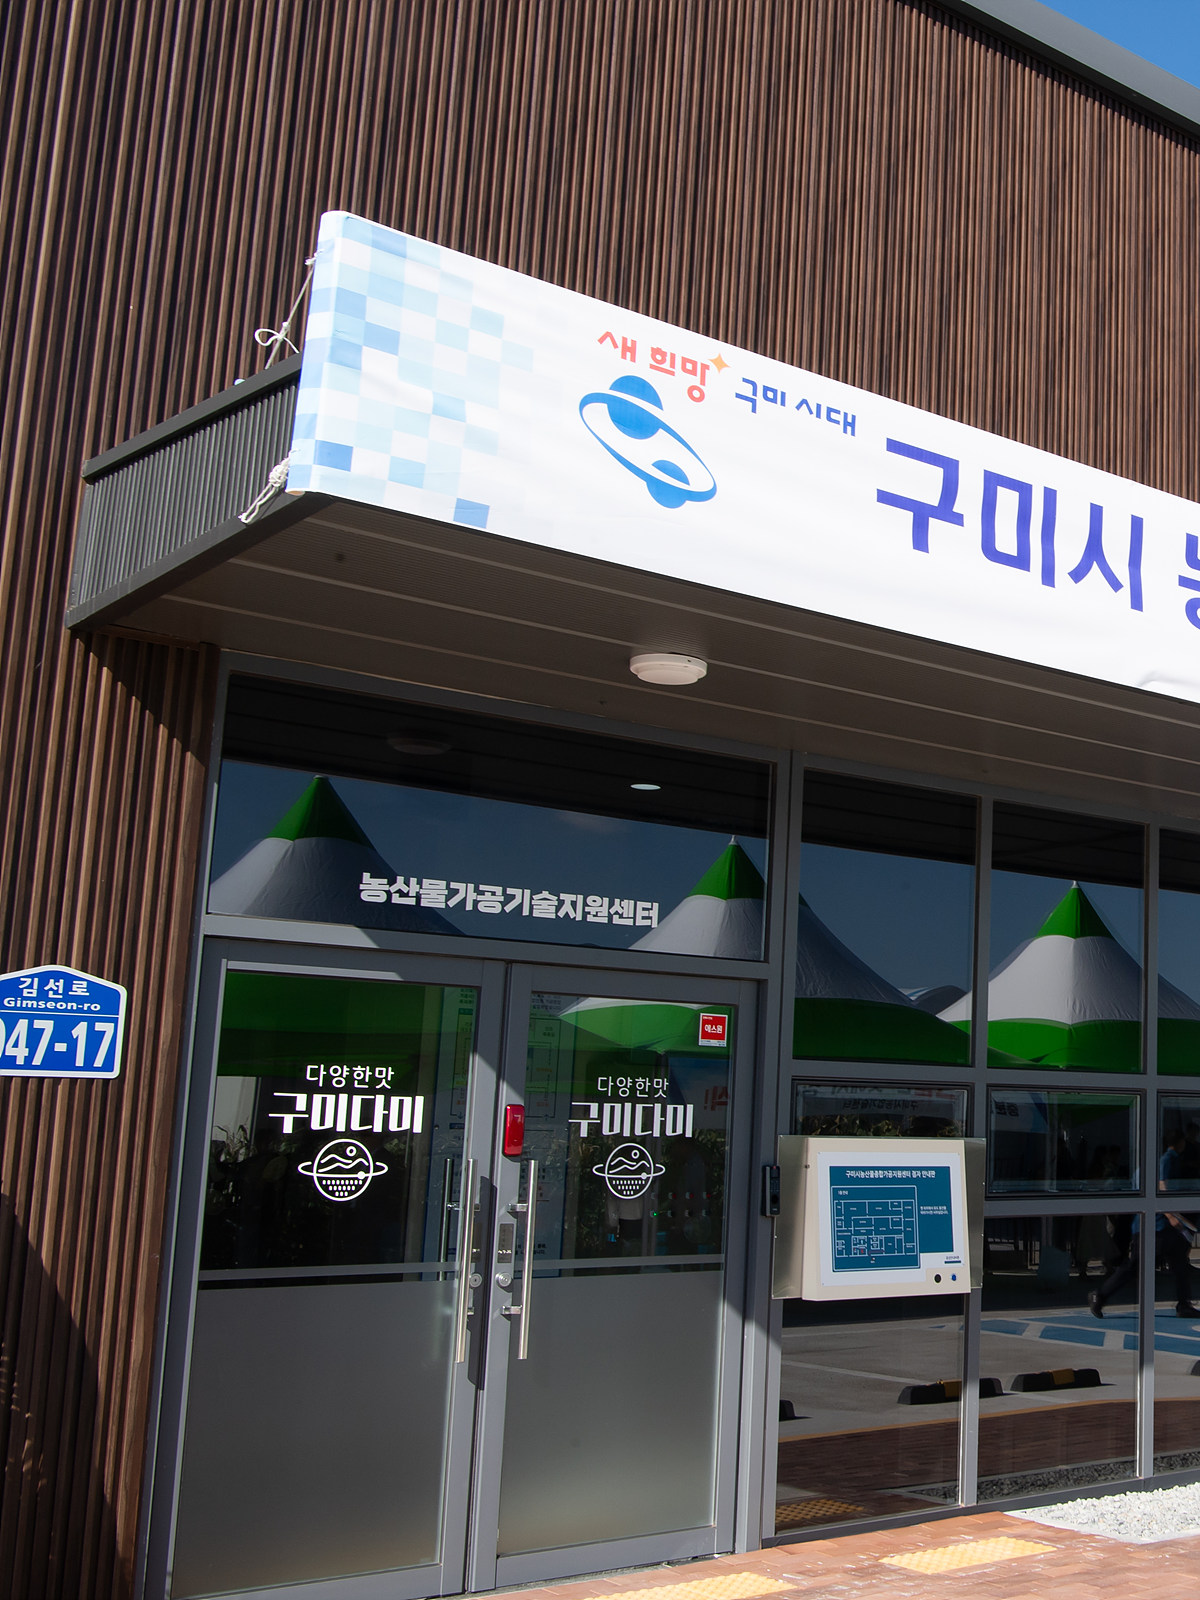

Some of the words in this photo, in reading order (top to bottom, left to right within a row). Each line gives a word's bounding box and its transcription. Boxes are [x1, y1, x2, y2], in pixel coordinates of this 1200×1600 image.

[876, 437, 1145, 613] 구미시
[359, 872, 660, 929] 농산물가공기술지원센터
[3, 997, 101, 1011] Gimseon-ro
[18, 977, 90, 999] 김선로
[0, 1017, 115, 1068] 47-17
[305, 1064, 395, 1090] 다양한맛
[597, 1075, 669, 1099] 다양한맛
[268, 1092, 424, 1135] 구미다미
[567, 1102, 694, 1138] 구미다미
